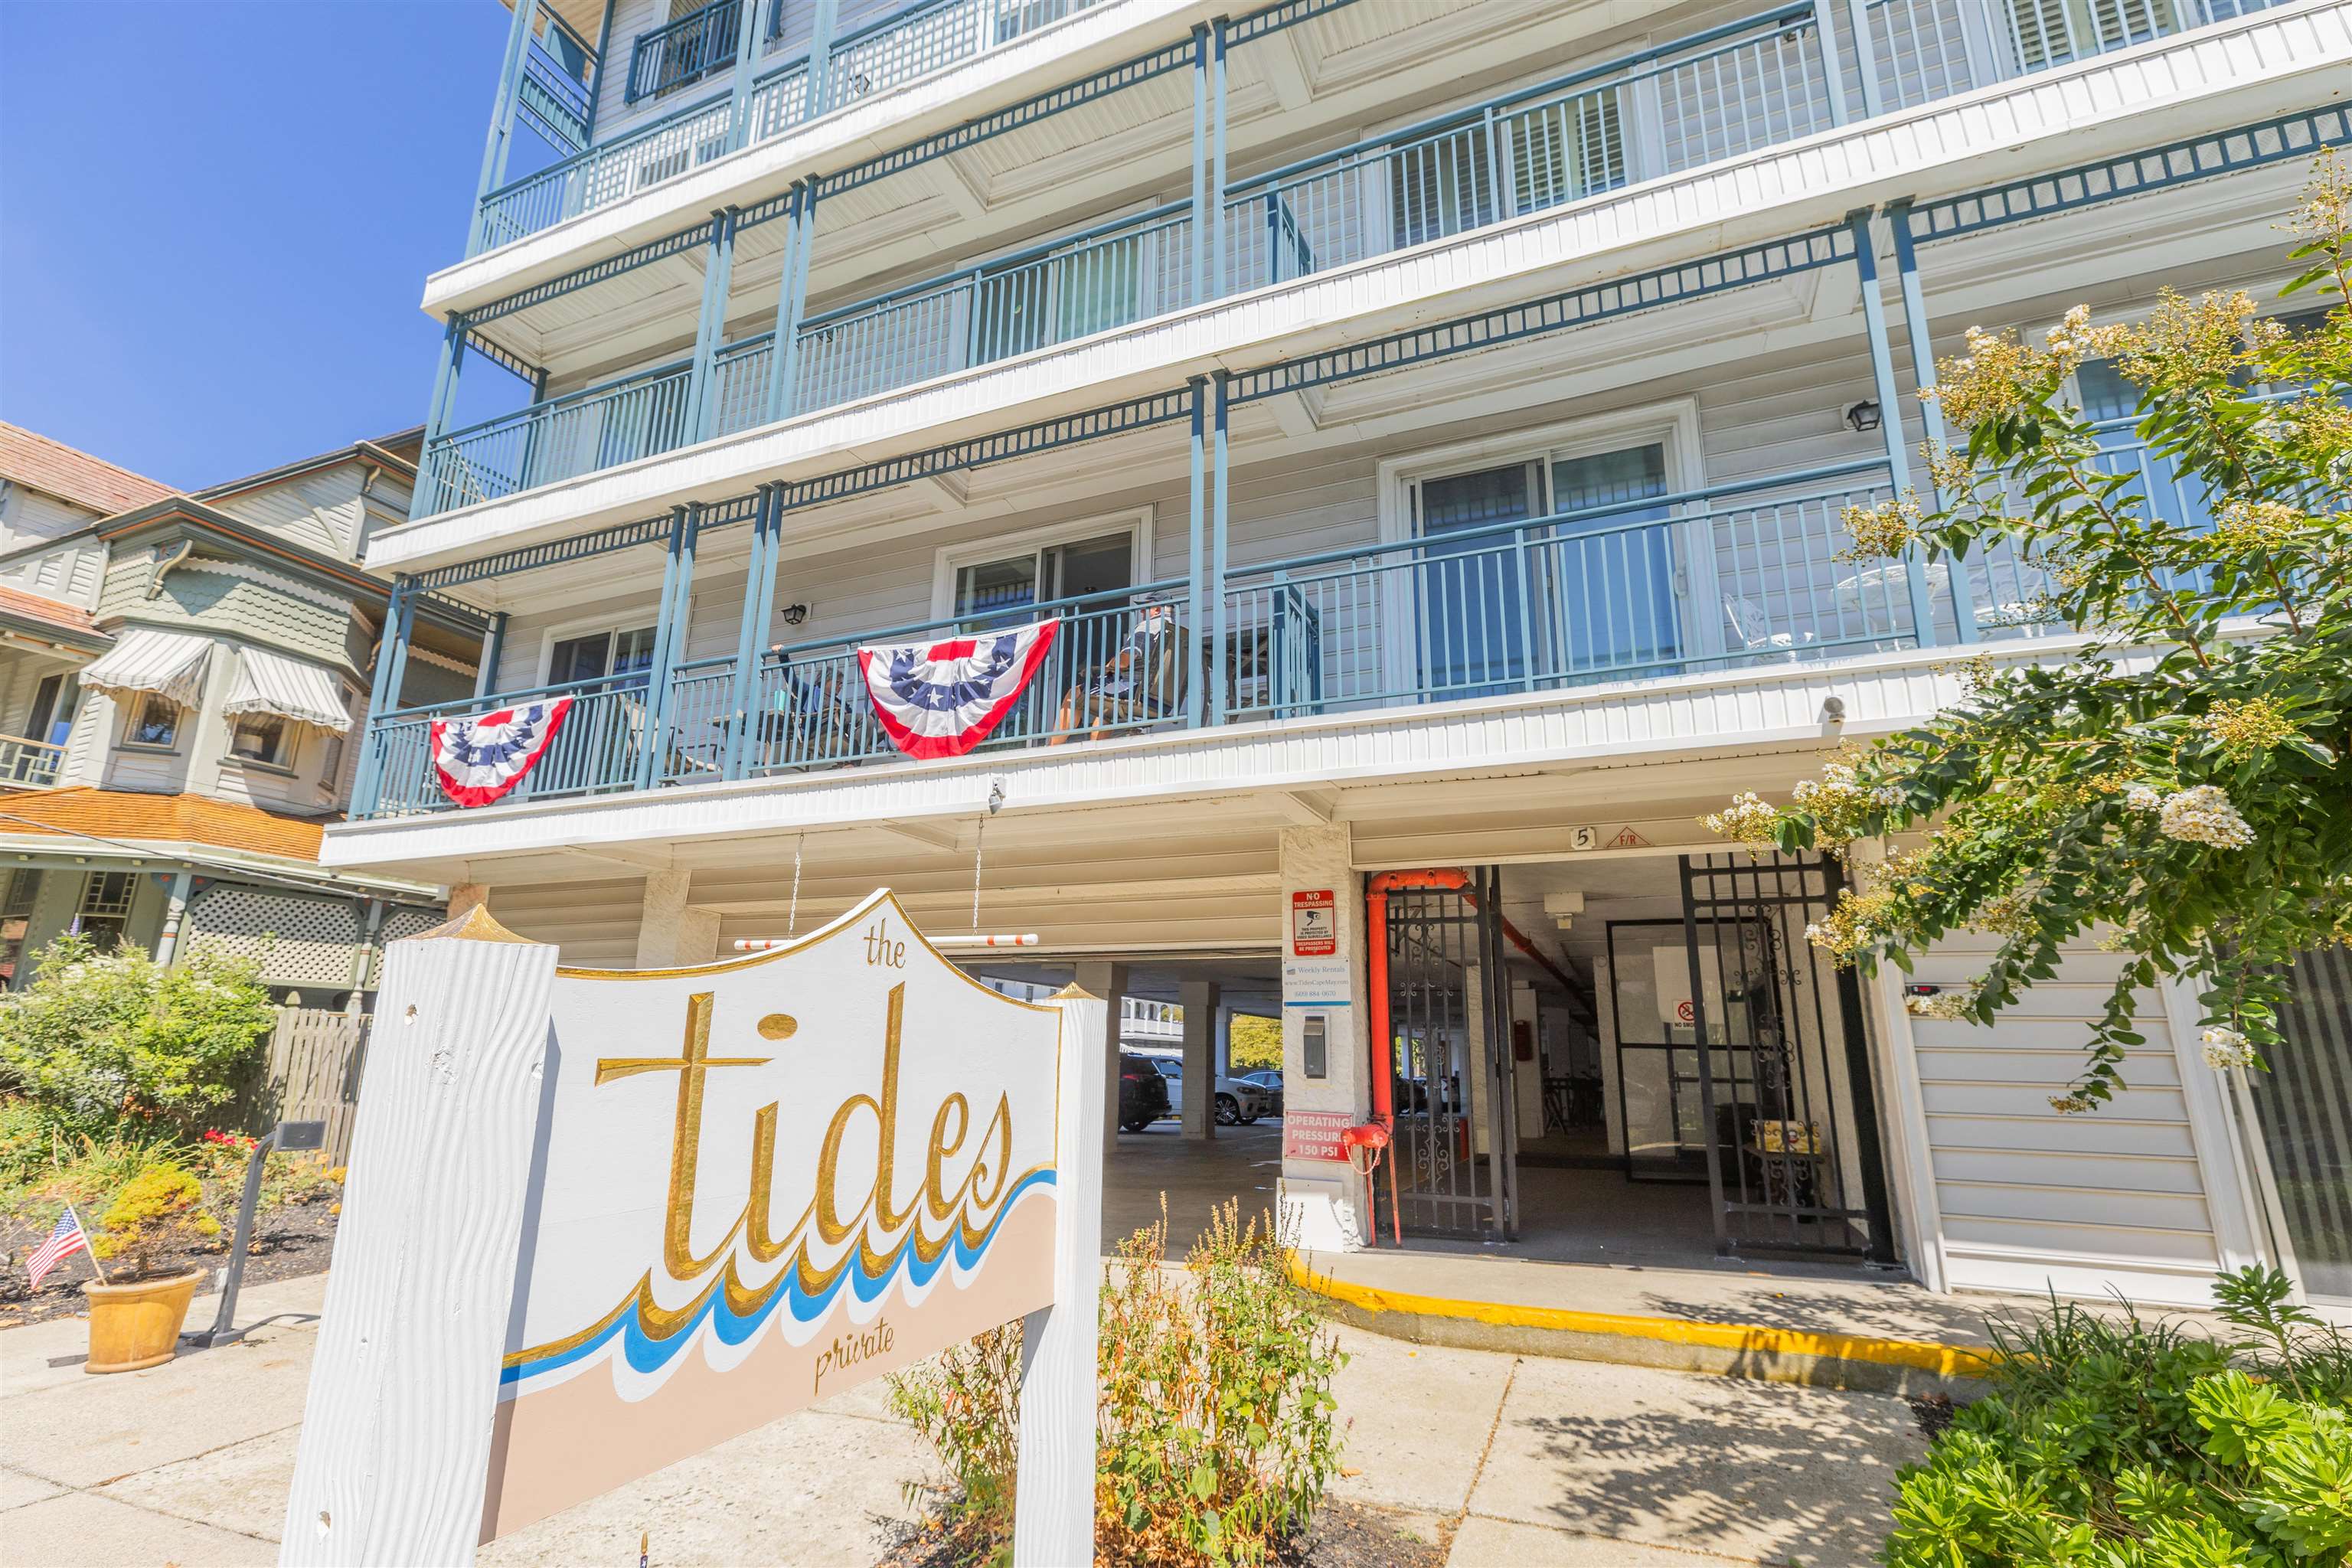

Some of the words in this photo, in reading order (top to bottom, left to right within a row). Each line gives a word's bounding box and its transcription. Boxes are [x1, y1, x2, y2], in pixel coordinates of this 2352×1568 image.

[1577, 828, 1589, 846] 5
[1619, 835, 1636, 846] F/R
[1294, 900, 1333, 908] TRESPASSING
[864, 917, 906, 969] the
[1287, 1115, 1350, 1128] OPERATING
[594, 982, 1012, 1281] tides
[1299, 1145, 1318, 1155] 150
[1321, 1146, 1338, 1157] PSI
[815, 1317, 894, 1396] private
